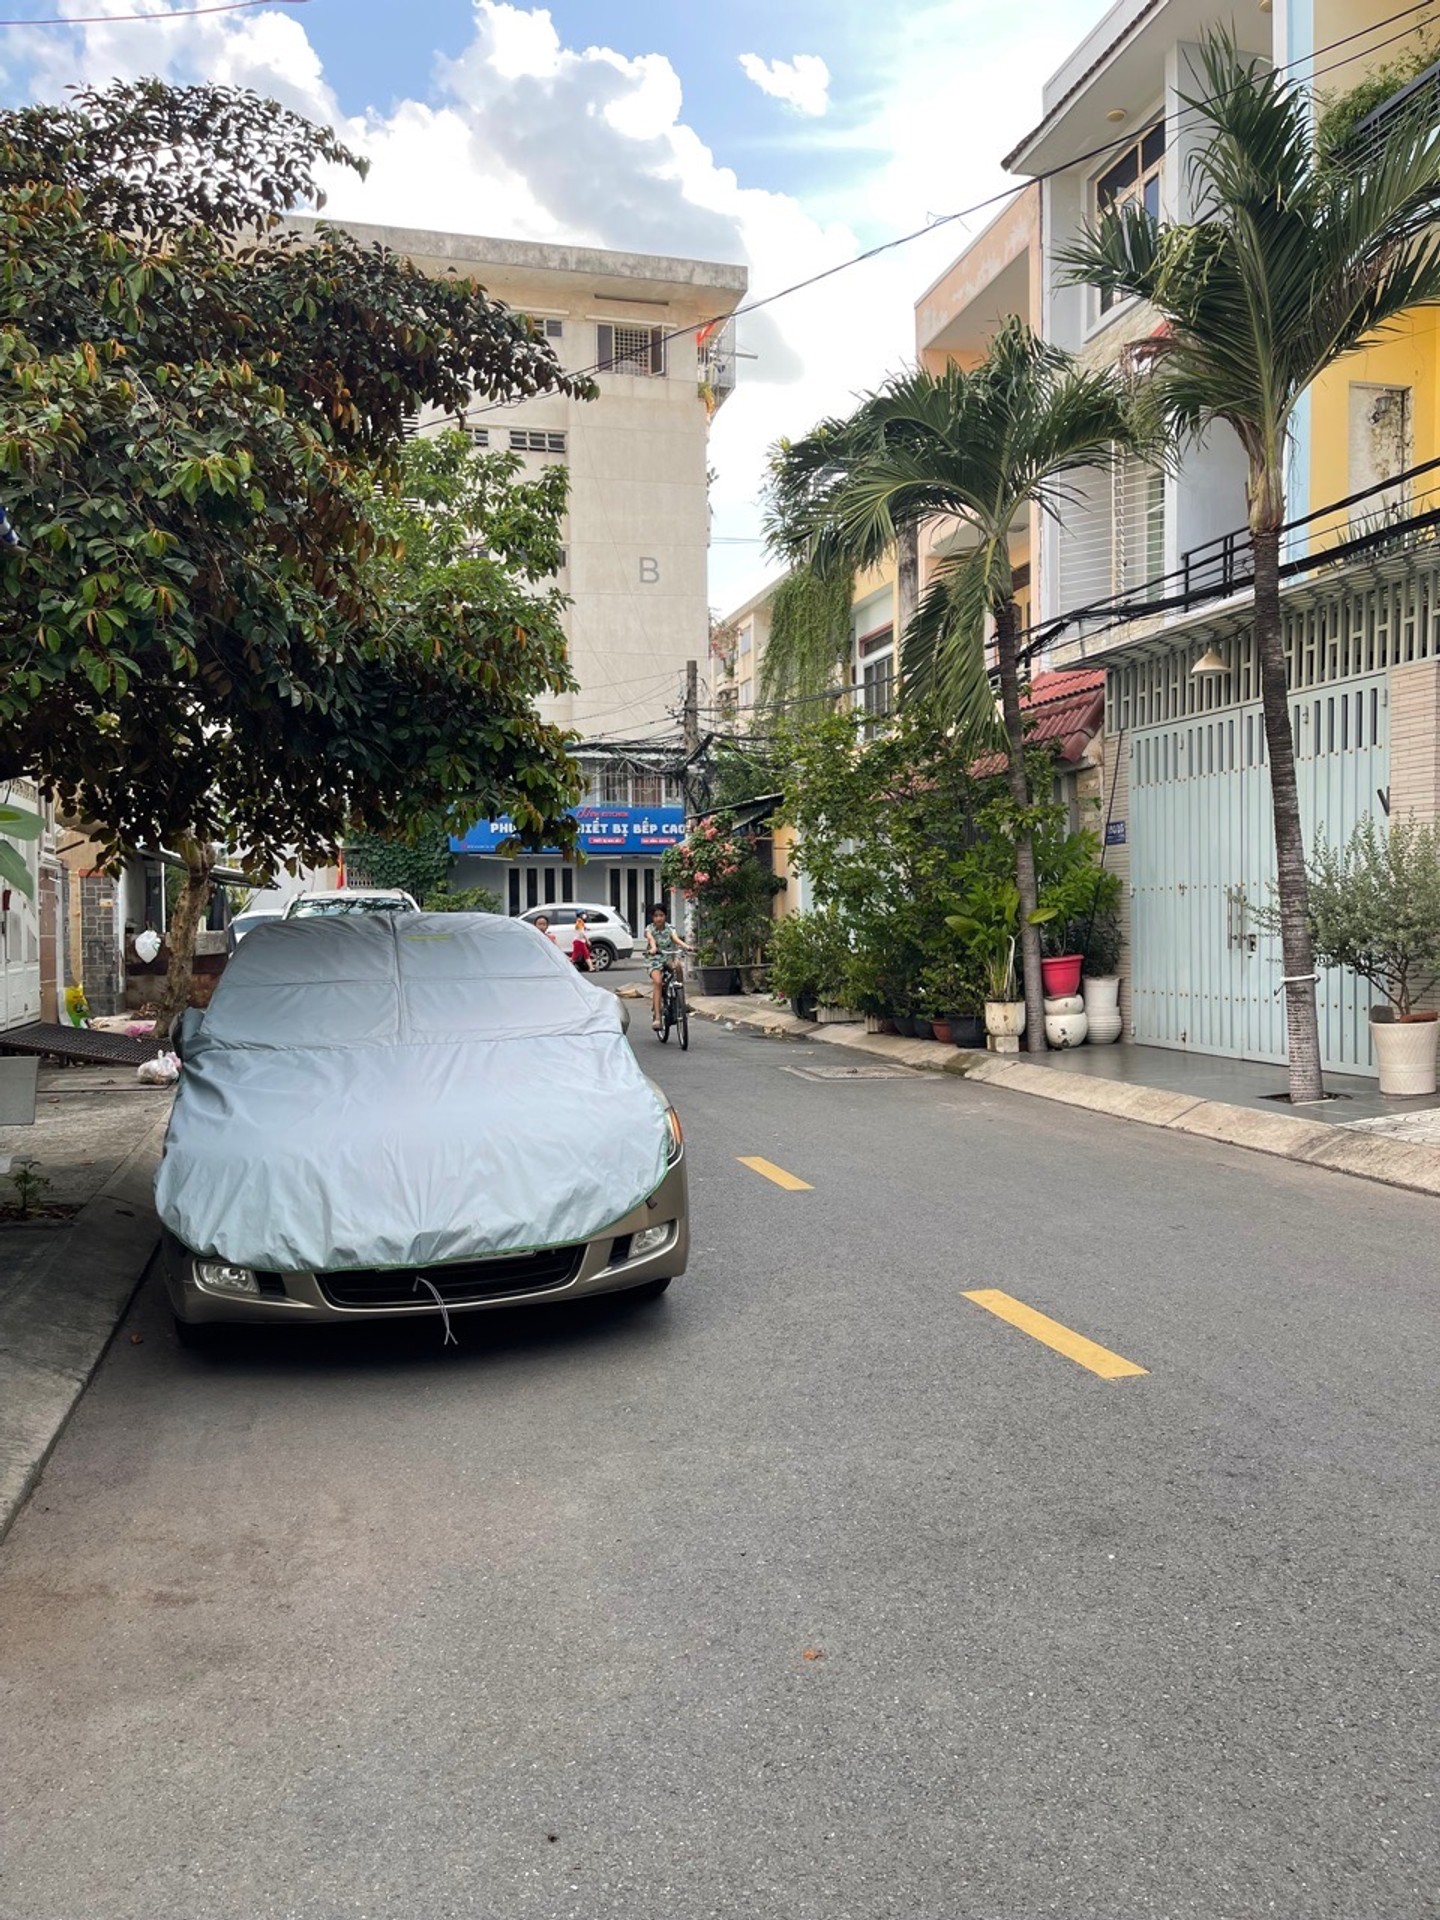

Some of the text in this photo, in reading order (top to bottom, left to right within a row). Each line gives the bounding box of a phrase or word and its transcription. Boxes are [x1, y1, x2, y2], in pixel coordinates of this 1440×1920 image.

[640, 557, 660, 584] B
[576, 817, 608, 833] HIẾT
[612, 823, 629, 837] BỊ
